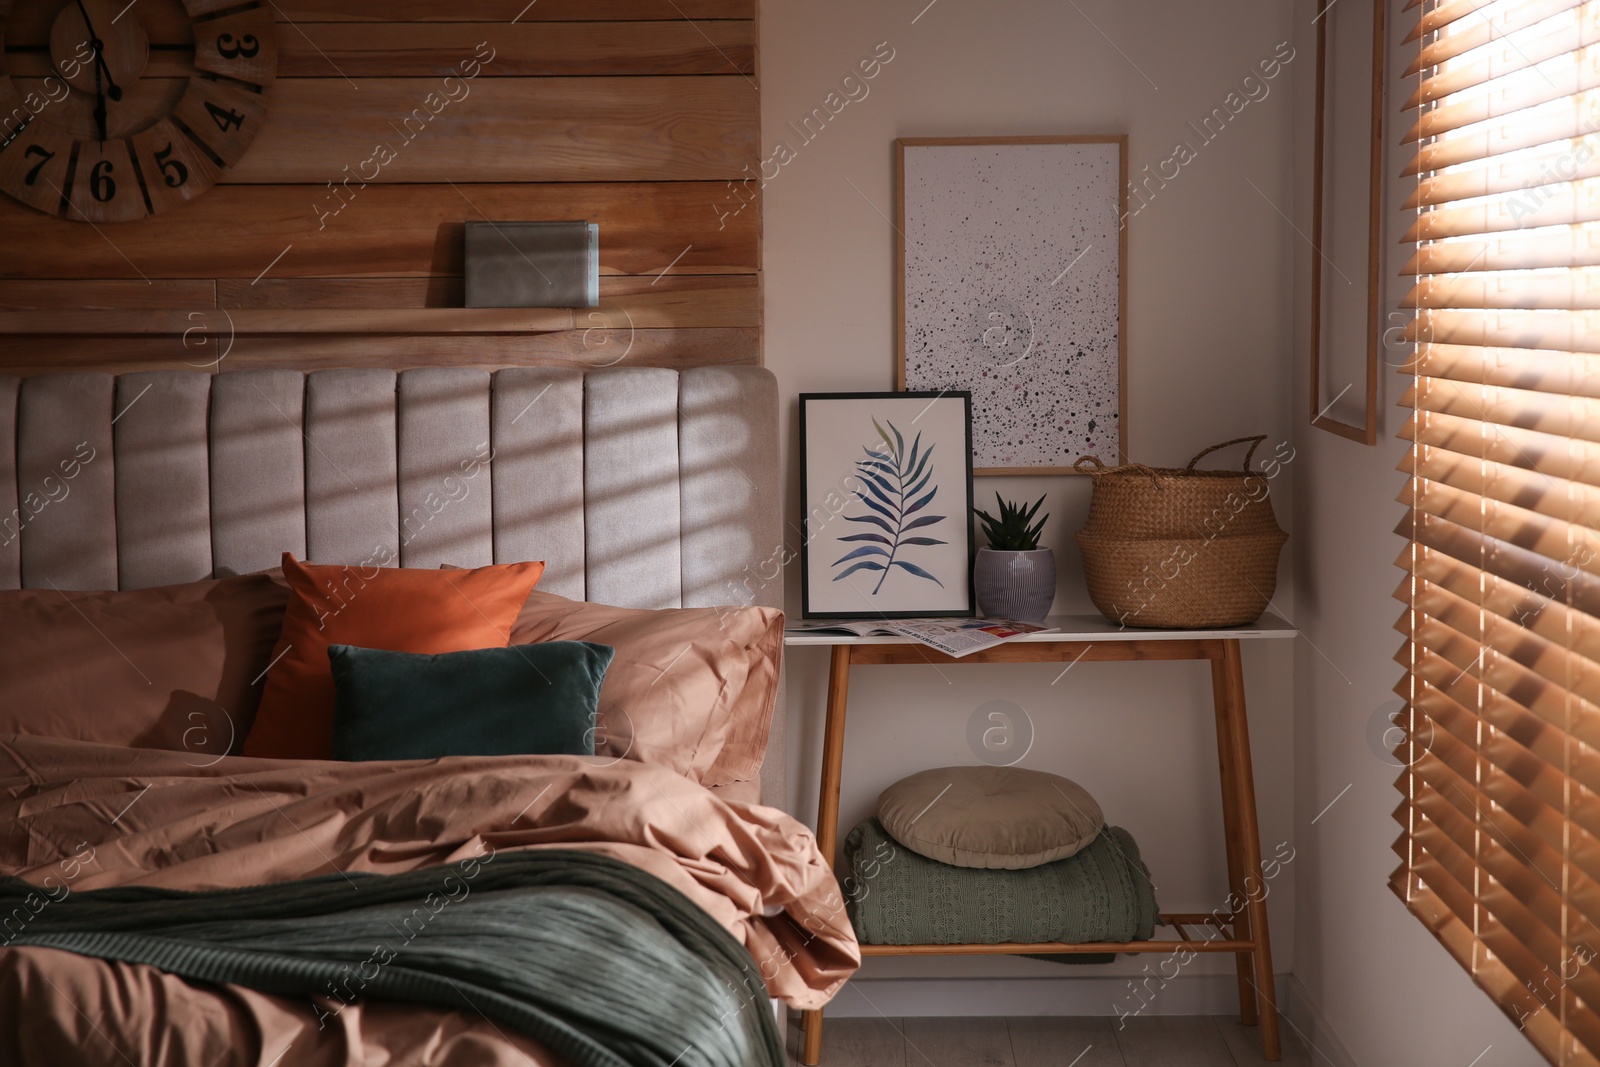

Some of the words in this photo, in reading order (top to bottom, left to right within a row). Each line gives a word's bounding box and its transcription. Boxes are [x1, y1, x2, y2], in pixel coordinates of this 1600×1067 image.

[216, 33, 260, 59] 3
[203, 101, 245, 133] 4
[24, 144, 55, 186] 7
[90, 160, 116, 202] 6
[153, 142, 189, 188] 5
